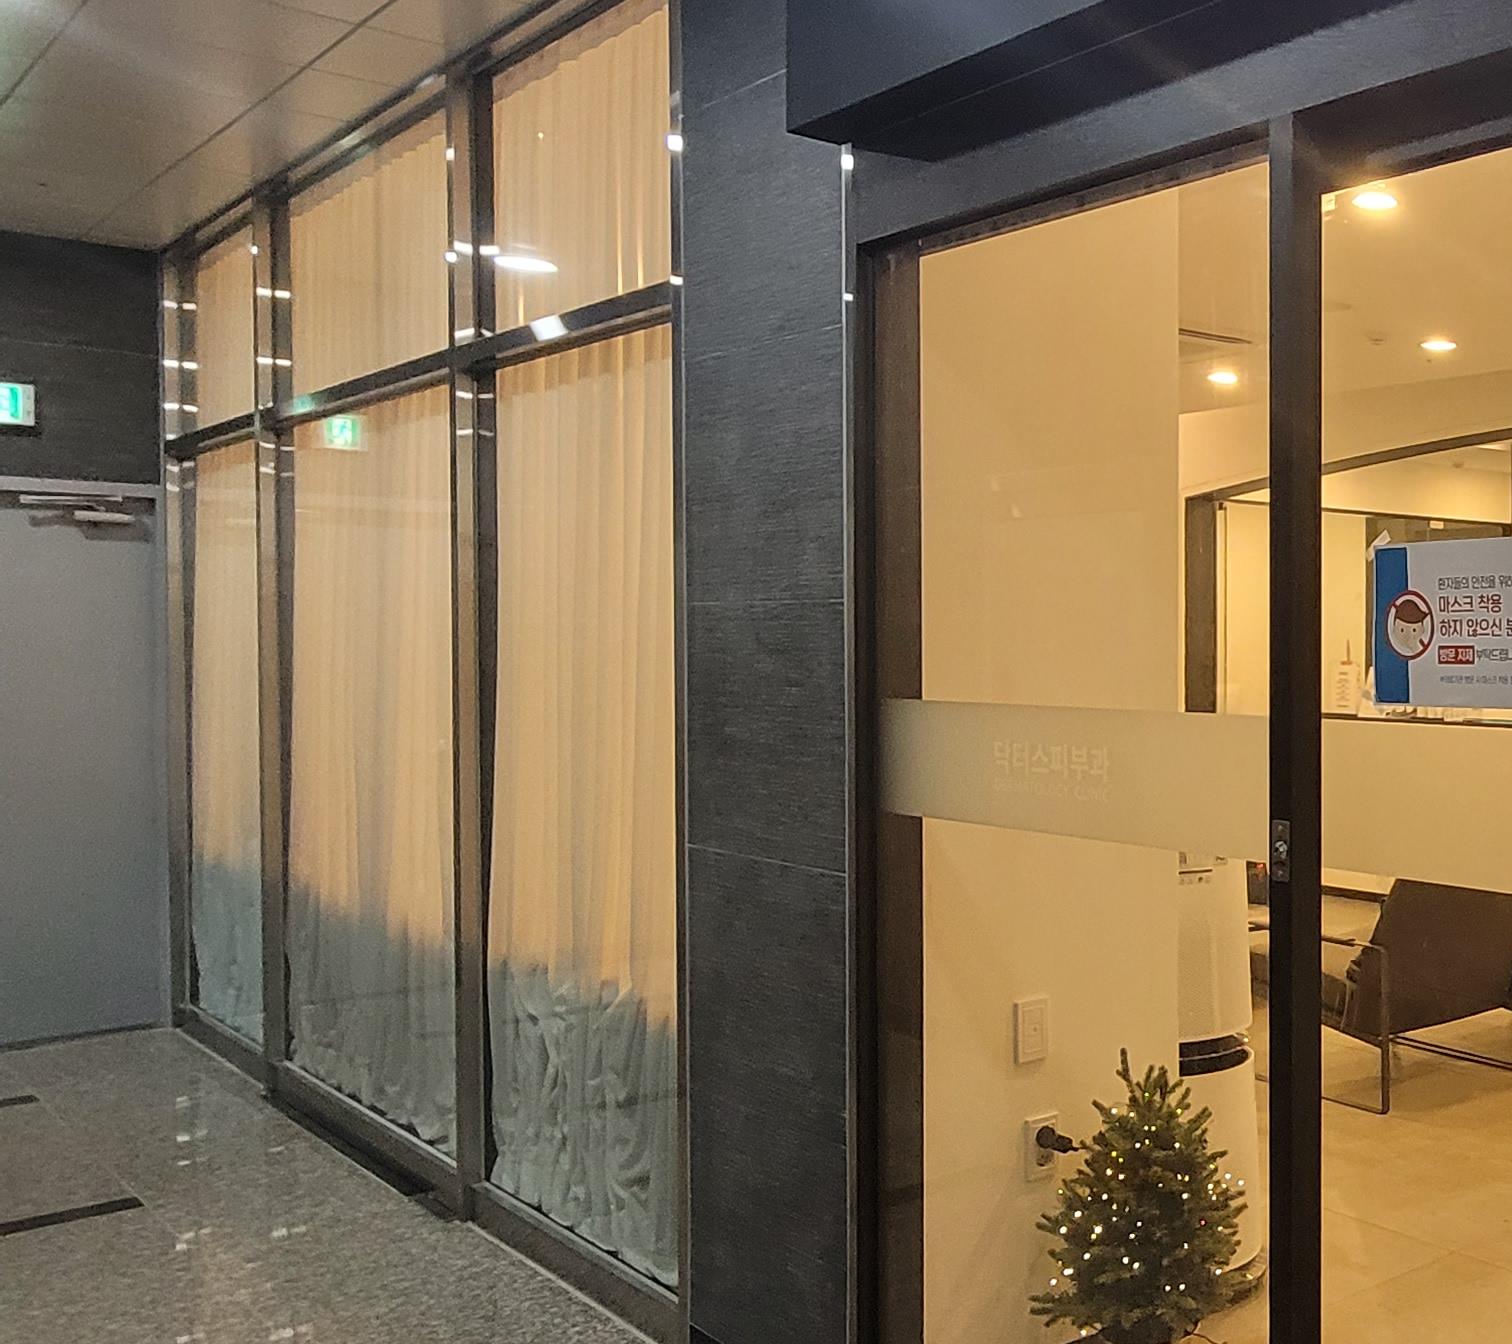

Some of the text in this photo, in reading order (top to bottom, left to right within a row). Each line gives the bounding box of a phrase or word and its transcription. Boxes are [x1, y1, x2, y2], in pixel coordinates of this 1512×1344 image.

[1471, 575, 1496, 589] 안전을
[1439, 594, 1502, 613] 마스크 착용
[1439, 619, 1463, 637] 하지
[1466, 618, 1502, 637] 않으신
[993, 740, 1111, 783] 닥터스피부과
